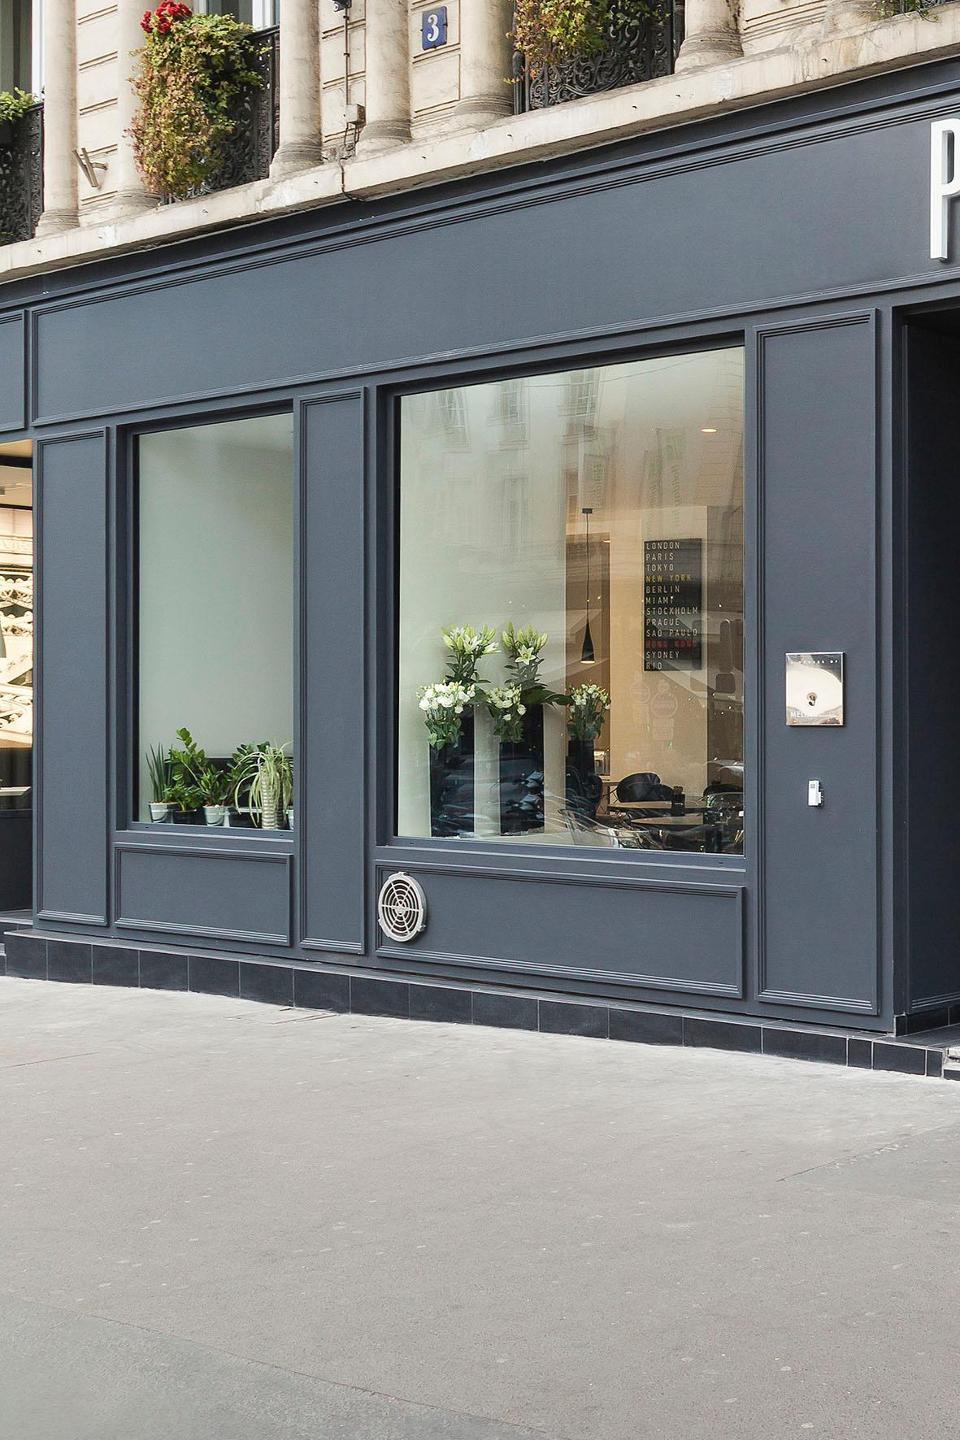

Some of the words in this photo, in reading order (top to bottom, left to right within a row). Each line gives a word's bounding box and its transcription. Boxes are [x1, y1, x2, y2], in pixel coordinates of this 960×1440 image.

[426, 13, 440, 42] 3
[646, 541, 680, 550] LONDON
[646, 552, 674, 561] PARIS
[646, 563, 674, 572] TOKYO
[646, 585, 680, 594] BERLIN
[646, 596, 674, 605] MIAMI
[646, 606, 698, 616] STOCKHOLM
[646, 618, 680, 626] PRAGUE
[646, 629, 663, 638] SAO
[670, 628, 698, 637] PAULO
[646, 651, 680, 659] SYDNEY
[646, 661, 663, 671] RIO
